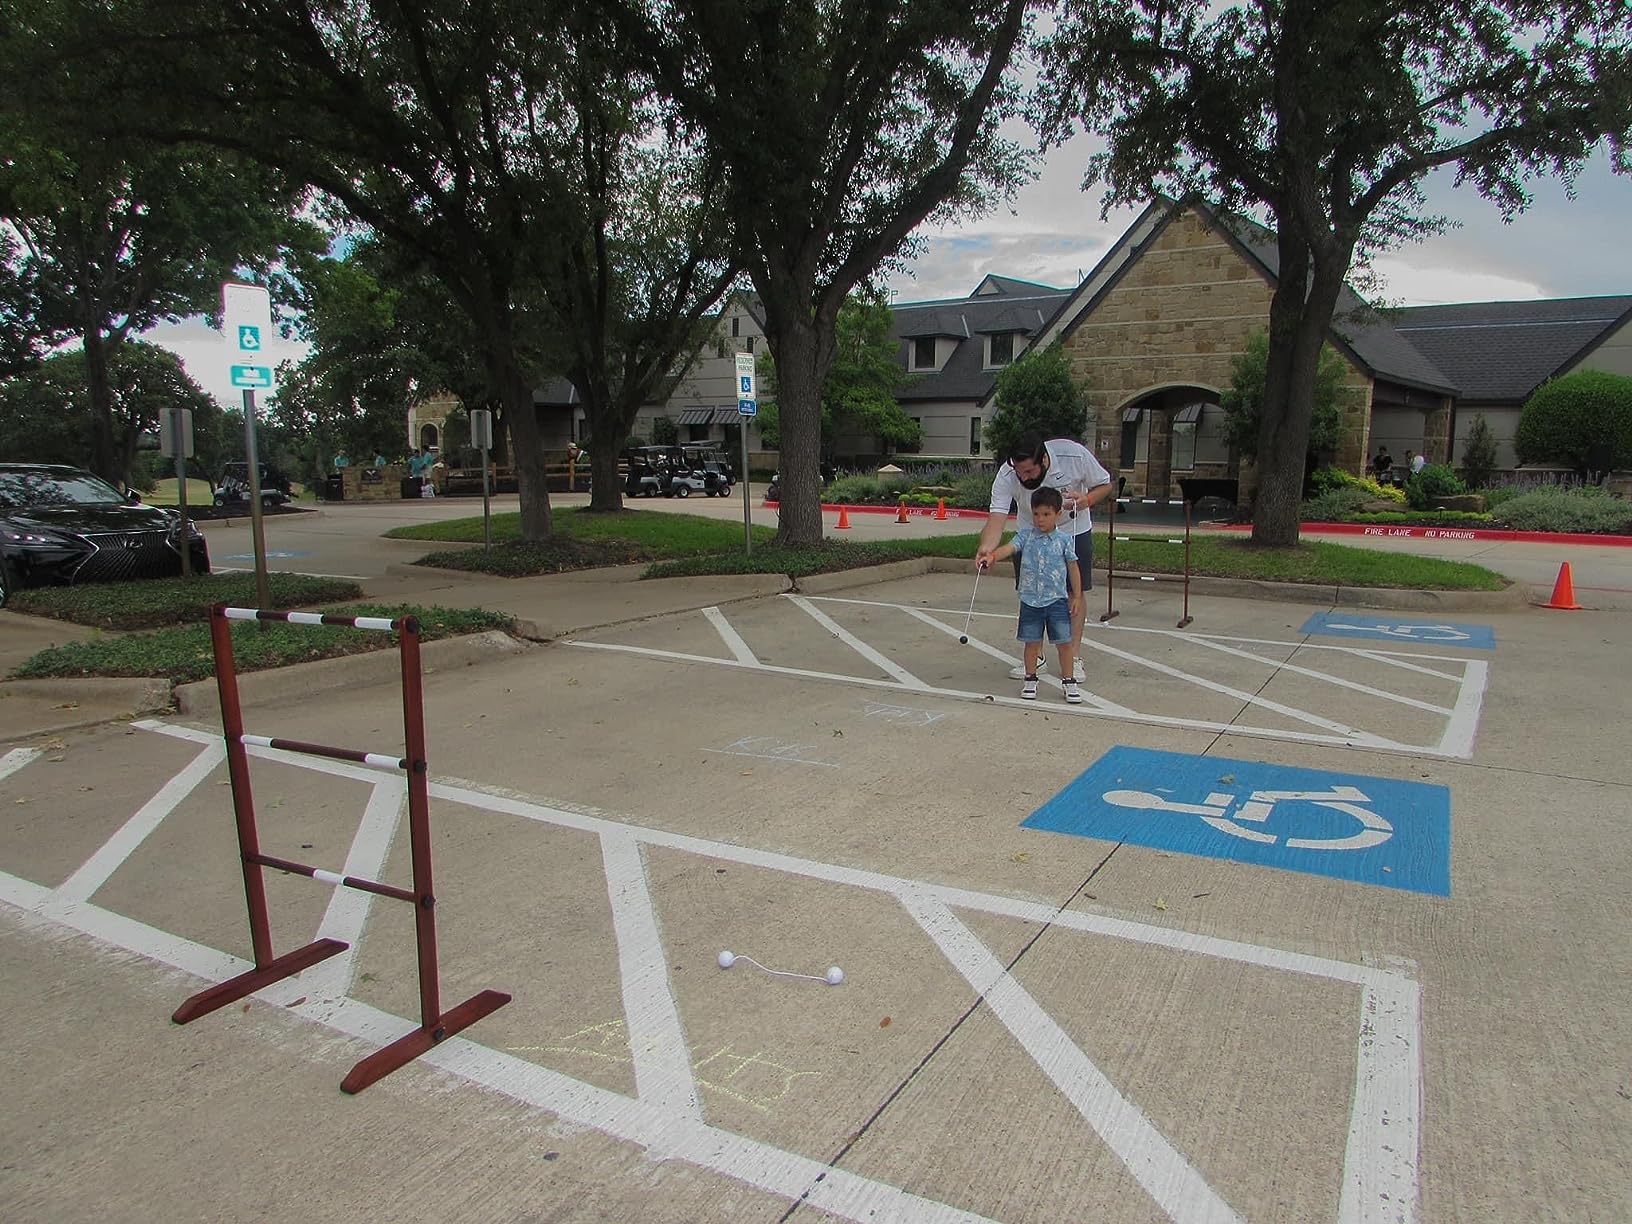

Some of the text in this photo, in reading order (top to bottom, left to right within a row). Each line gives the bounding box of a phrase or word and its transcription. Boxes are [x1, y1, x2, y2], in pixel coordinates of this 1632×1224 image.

[1364, 527, 1384, 536] FIRE
[1388, 528, 1412, 537] LANE
[1439, 530, 1475, 540] PARKING
